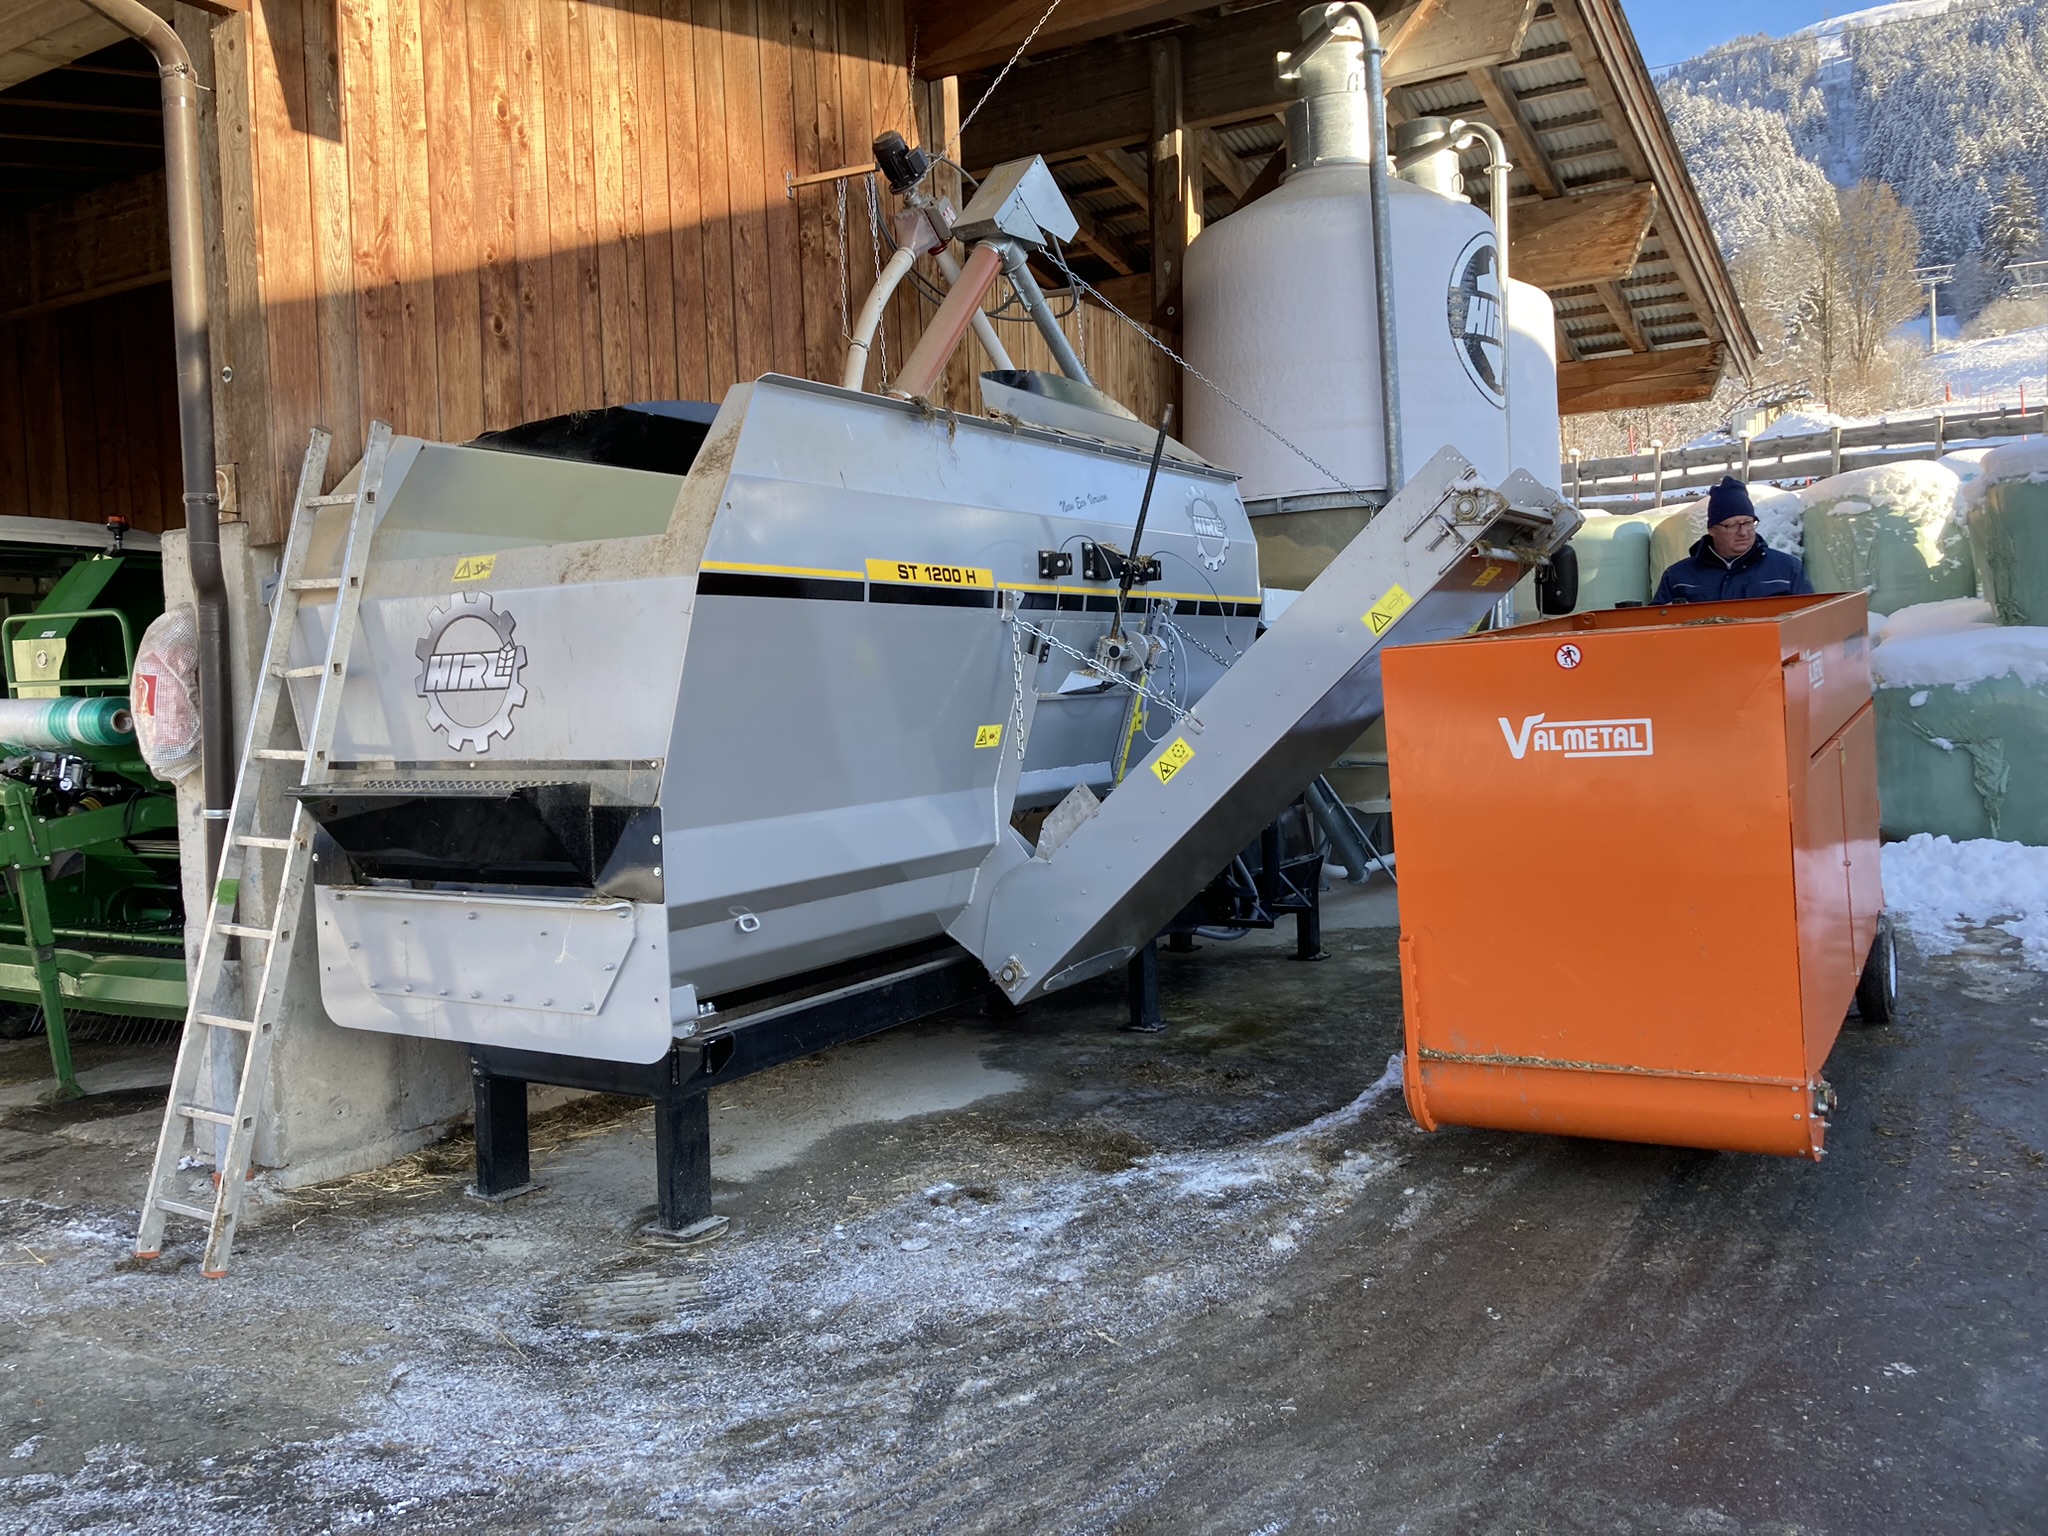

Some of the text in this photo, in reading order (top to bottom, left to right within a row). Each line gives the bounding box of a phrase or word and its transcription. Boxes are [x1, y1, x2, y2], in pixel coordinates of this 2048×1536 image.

[897, 564, 977, 584] ST 1200 H
[423, 644, 517, 693] HIRL
[1498, 712, 1653, 760] VALMETAL
